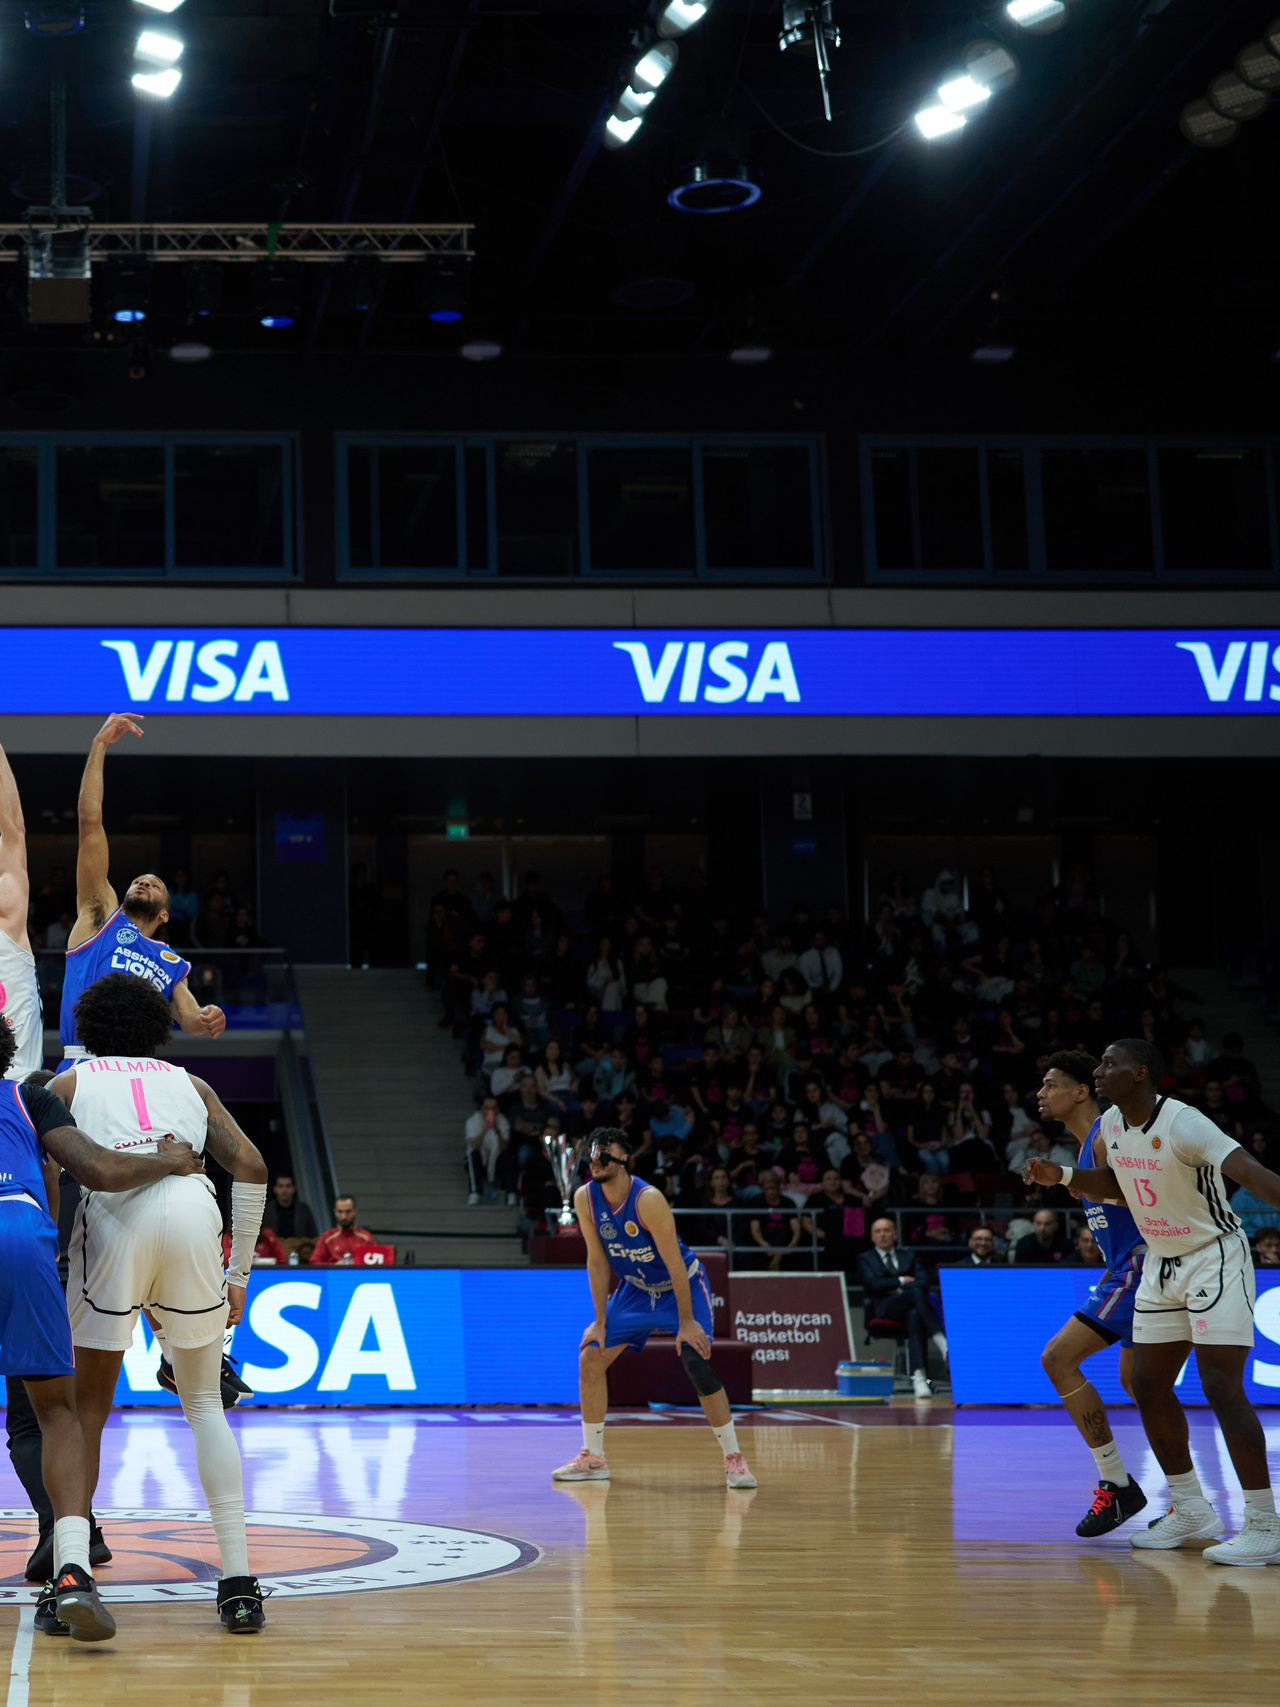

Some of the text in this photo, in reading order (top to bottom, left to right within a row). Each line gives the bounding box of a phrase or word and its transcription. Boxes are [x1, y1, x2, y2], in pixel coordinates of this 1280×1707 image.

[101, 640, 289, 702] VISA
[613, 641, 801, 703] VISA
[113, 945, 173, 985] ABSHERON
[130, 1077, 153, 1132] 1
[1114, 1155, 1163, 1172] SABAH BC
[1132, 1177, 1158, 1208] 13
[1144, 1216, 1170, 1228] Bank
[734, 1310, 832, 1328] Azərbaycan
[736, 1327, 821, 1344] Basketbol
